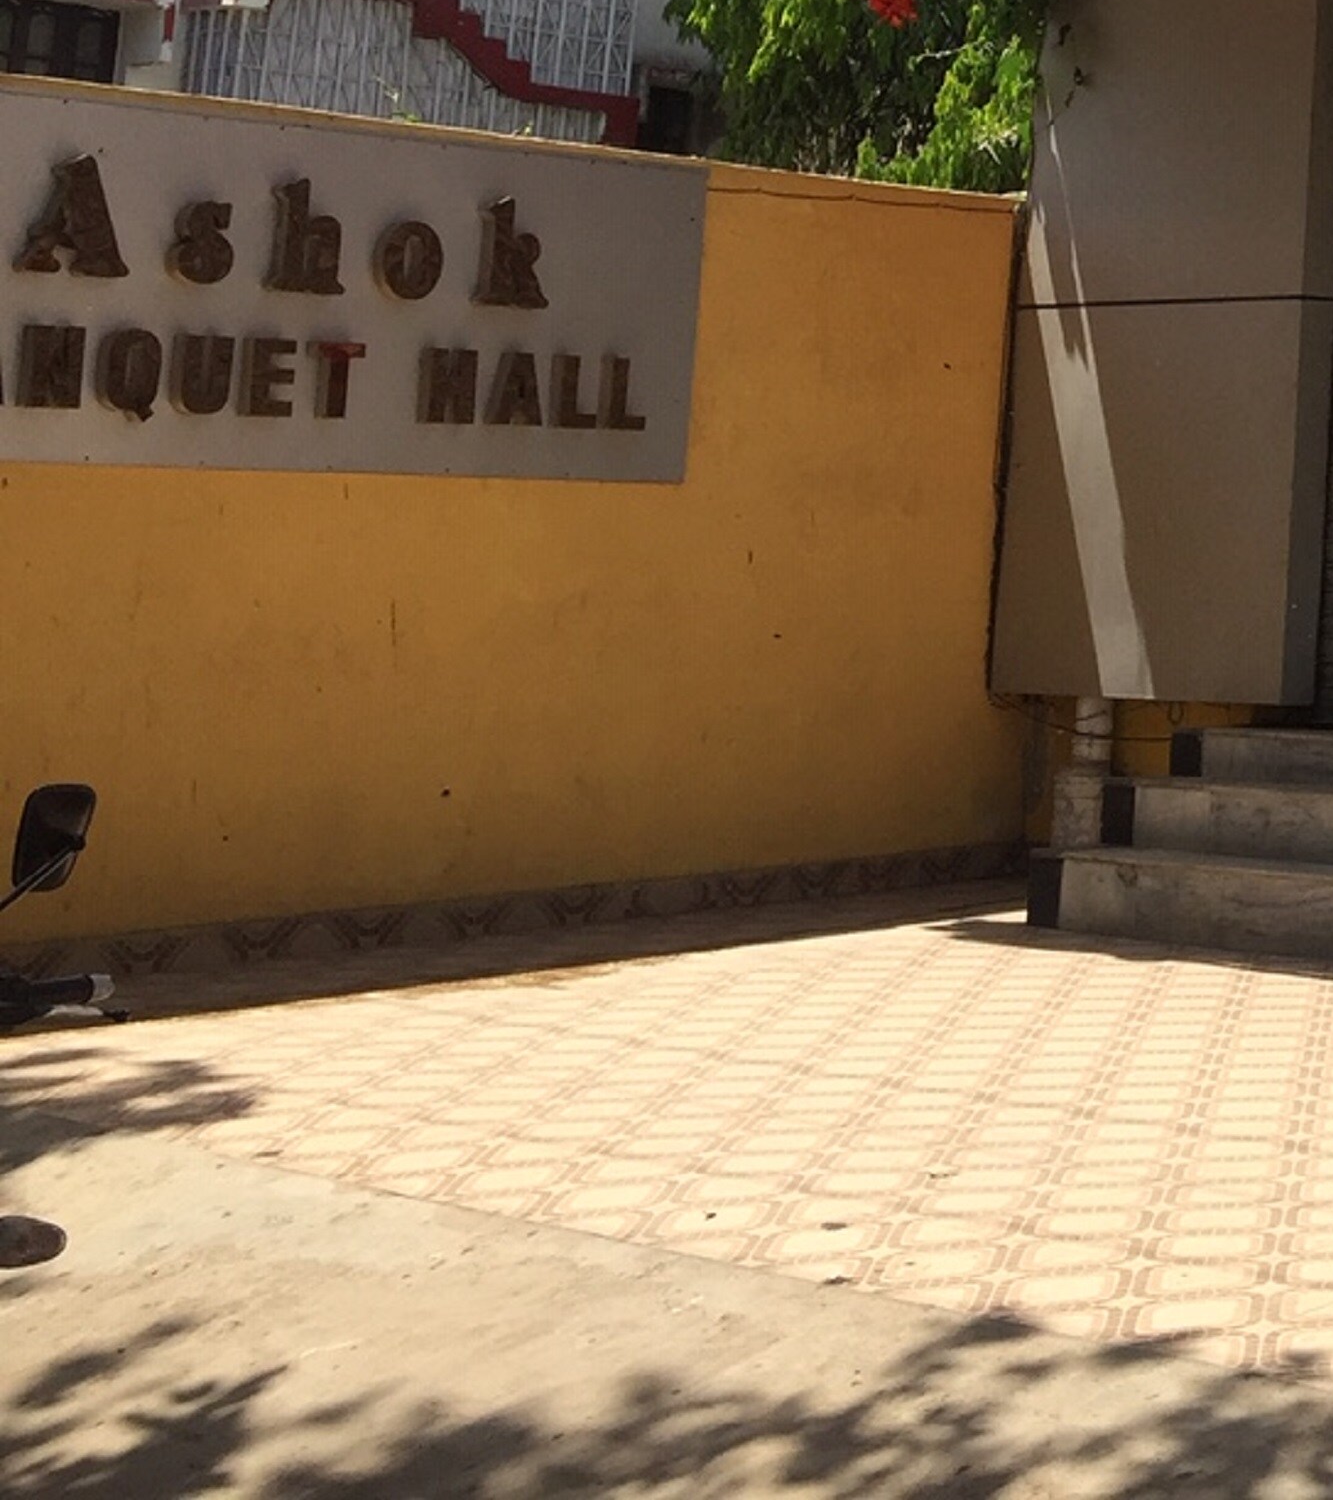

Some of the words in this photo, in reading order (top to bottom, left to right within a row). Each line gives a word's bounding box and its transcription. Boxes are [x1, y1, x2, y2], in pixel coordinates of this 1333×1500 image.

[12, 153, 549, 308] Ashok
[0, 324, 366, 421] NQUET
[416, 347, 646, 431] HALL
